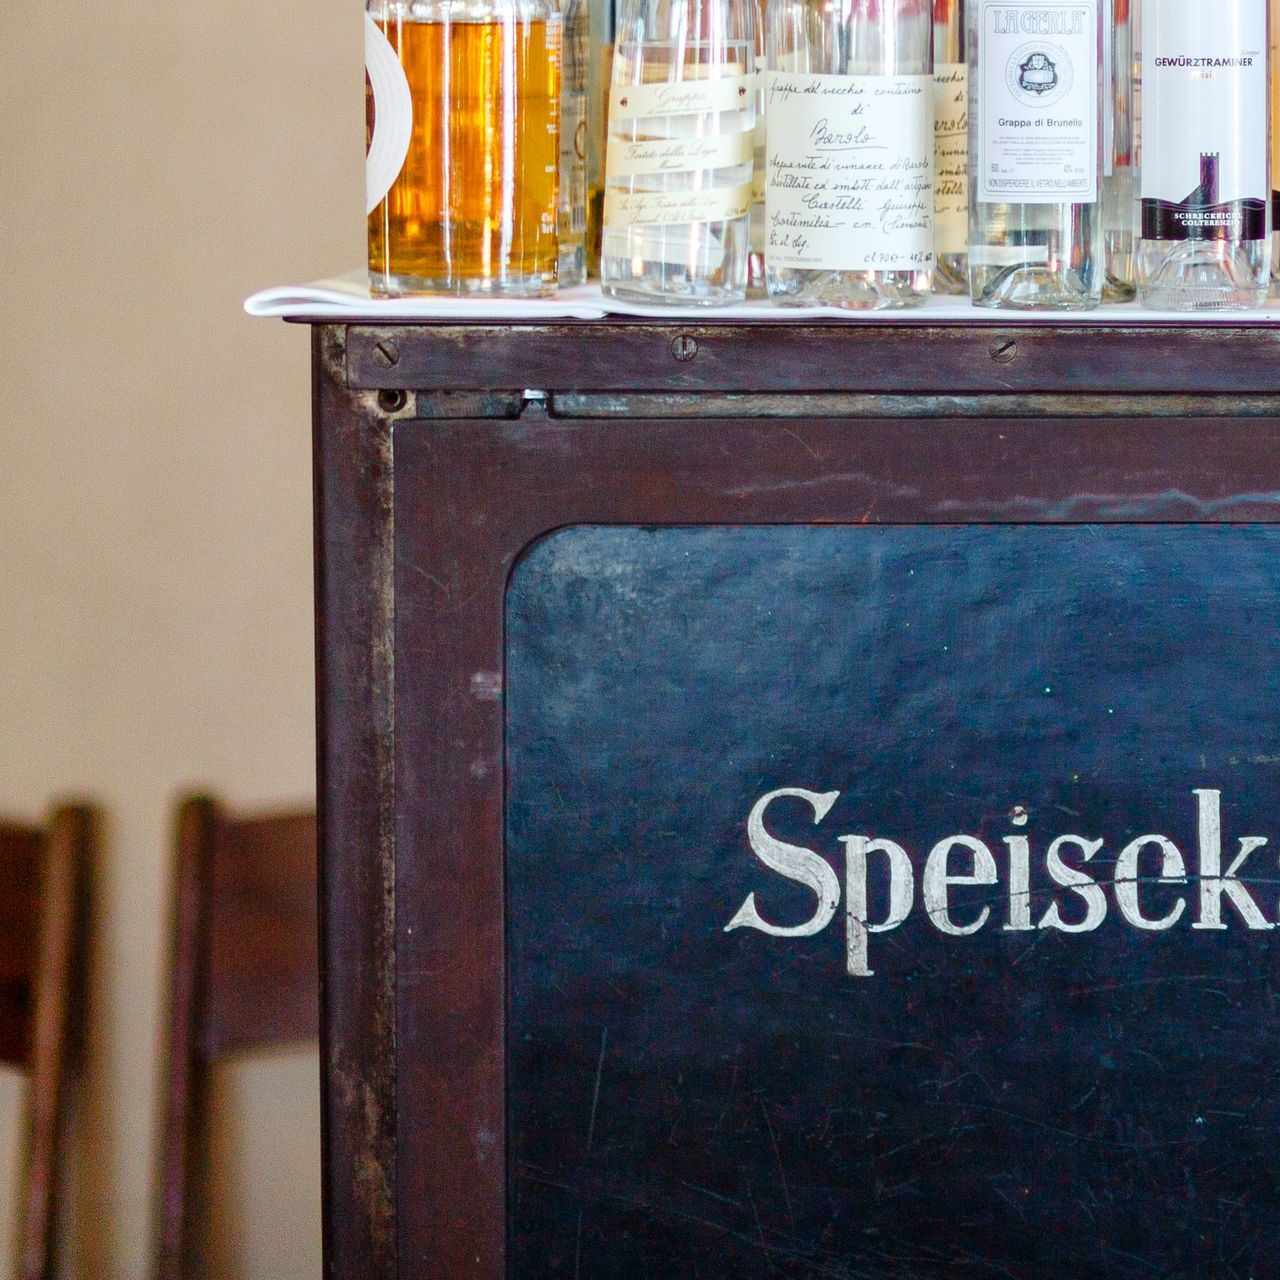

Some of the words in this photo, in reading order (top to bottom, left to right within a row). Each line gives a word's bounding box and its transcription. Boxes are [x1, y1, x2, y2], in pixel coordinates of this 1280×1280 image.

[994, 10, 1019, 33] LA
[1020, 11, 1083, 34] GERLA
[1154, 54, 1253, 67] GEWÜRZTRAMINER
[851, 104, 870, 115] di
[998, 118, 1031, 128] Grappa
[1035, 118, 1043, 126] di
[1047, 118, 1083, 127] Brunello
[810, 118, 875, 146] Barolo
[802, 193, 867, 211] Castelli
